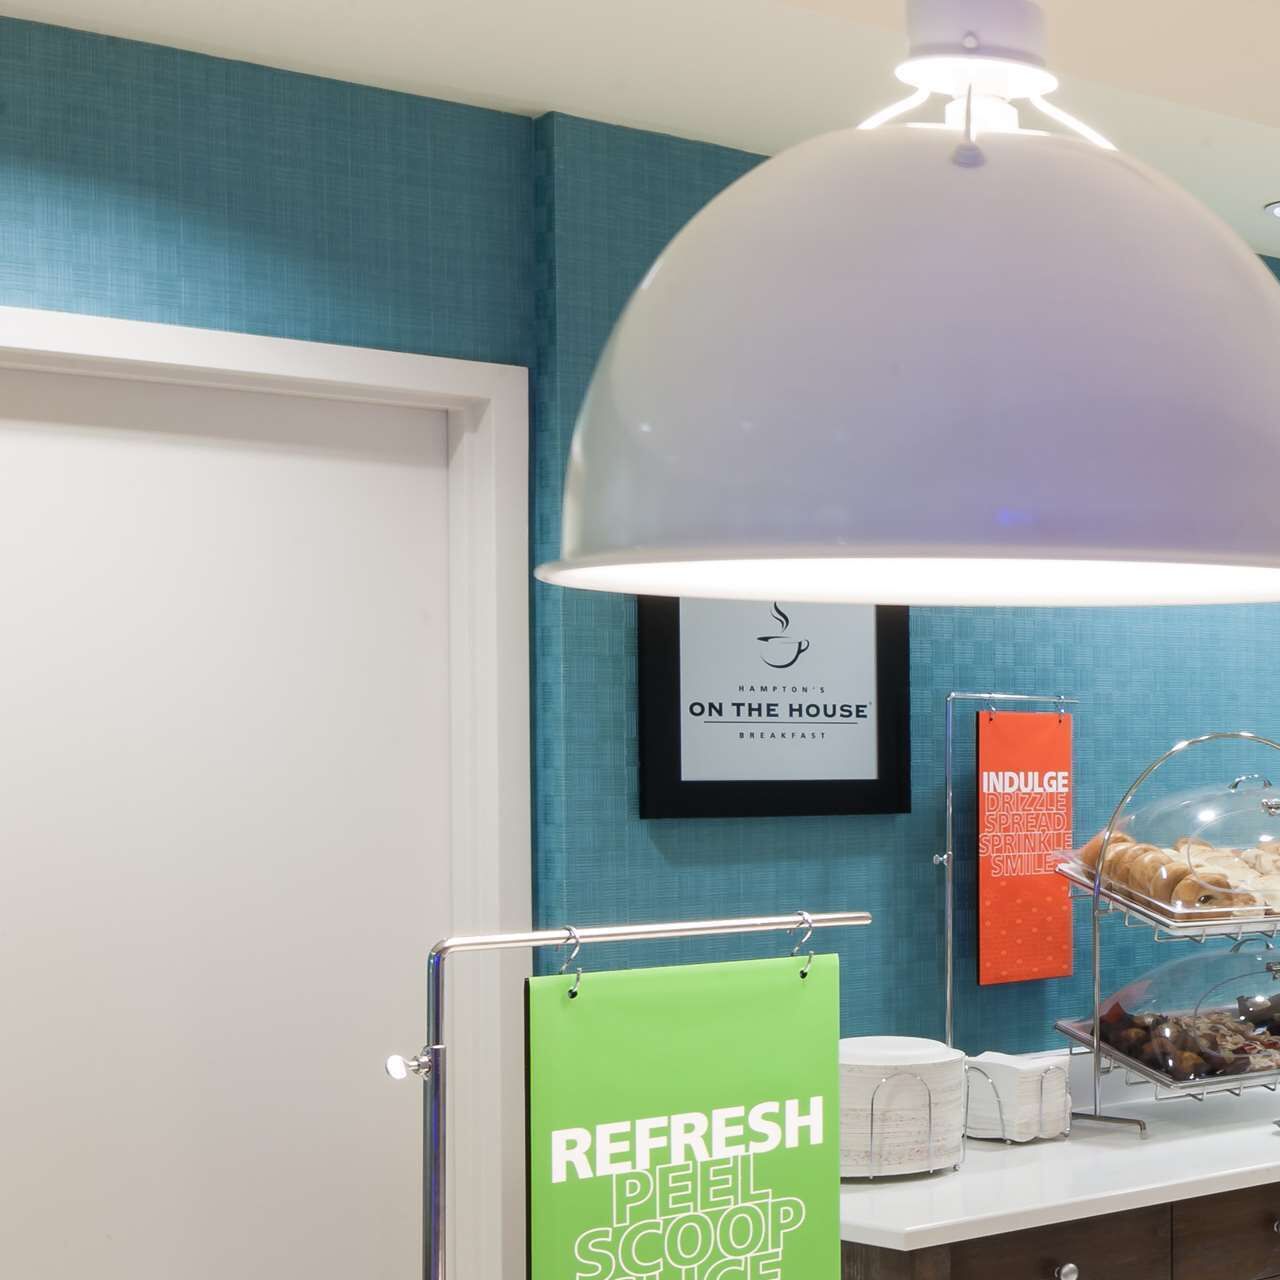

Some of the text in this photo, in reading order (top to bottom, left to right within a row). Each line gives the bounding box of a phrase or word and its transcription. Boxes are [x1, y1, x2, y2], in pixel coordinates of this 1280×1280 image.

[738, 684, 825, 694] HAMPTON'S
[688, 701, 868, 718] ON THE HOUSE
[739, 731, 826, 740] BREAKFAST
[983, 771, 1069, 793] INDULGE
[985, 792, 1066, 813] DRIZZLE
[984, 812, 1066, 834] SPREAD
[978, 831, 1073, 856] SPRINKLE
[550, 1096, 824, 1184] REFRESH
[612, 1152, 773, 1229] PEEL
